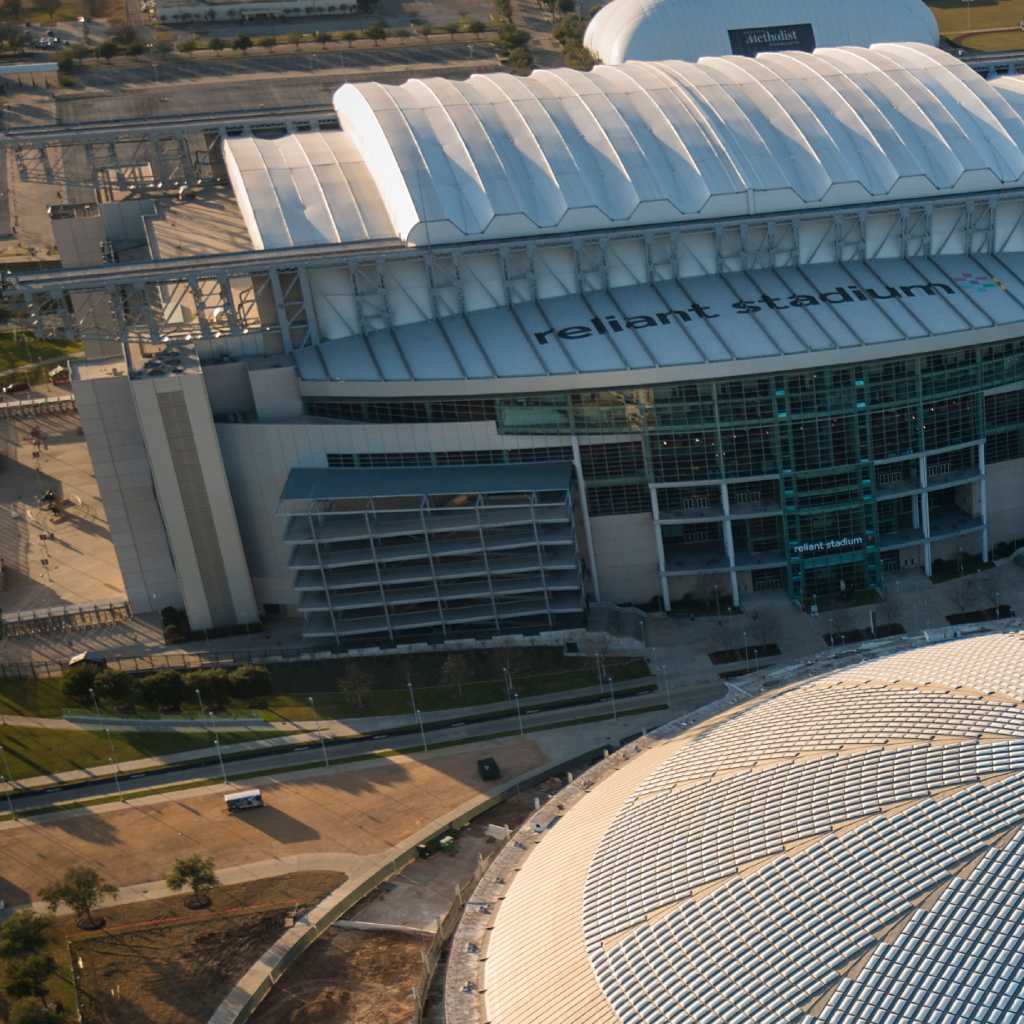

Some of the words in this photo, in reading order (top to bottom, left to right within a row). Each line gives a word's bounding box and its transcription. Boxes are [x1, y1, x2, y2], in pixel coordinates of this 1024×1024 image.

[534, 303, 720, 345] reliant
[732, 282, 955, 314] stadium
[795, 542, 824, 553] reliant
[826, 537, 862, 549] stadium
